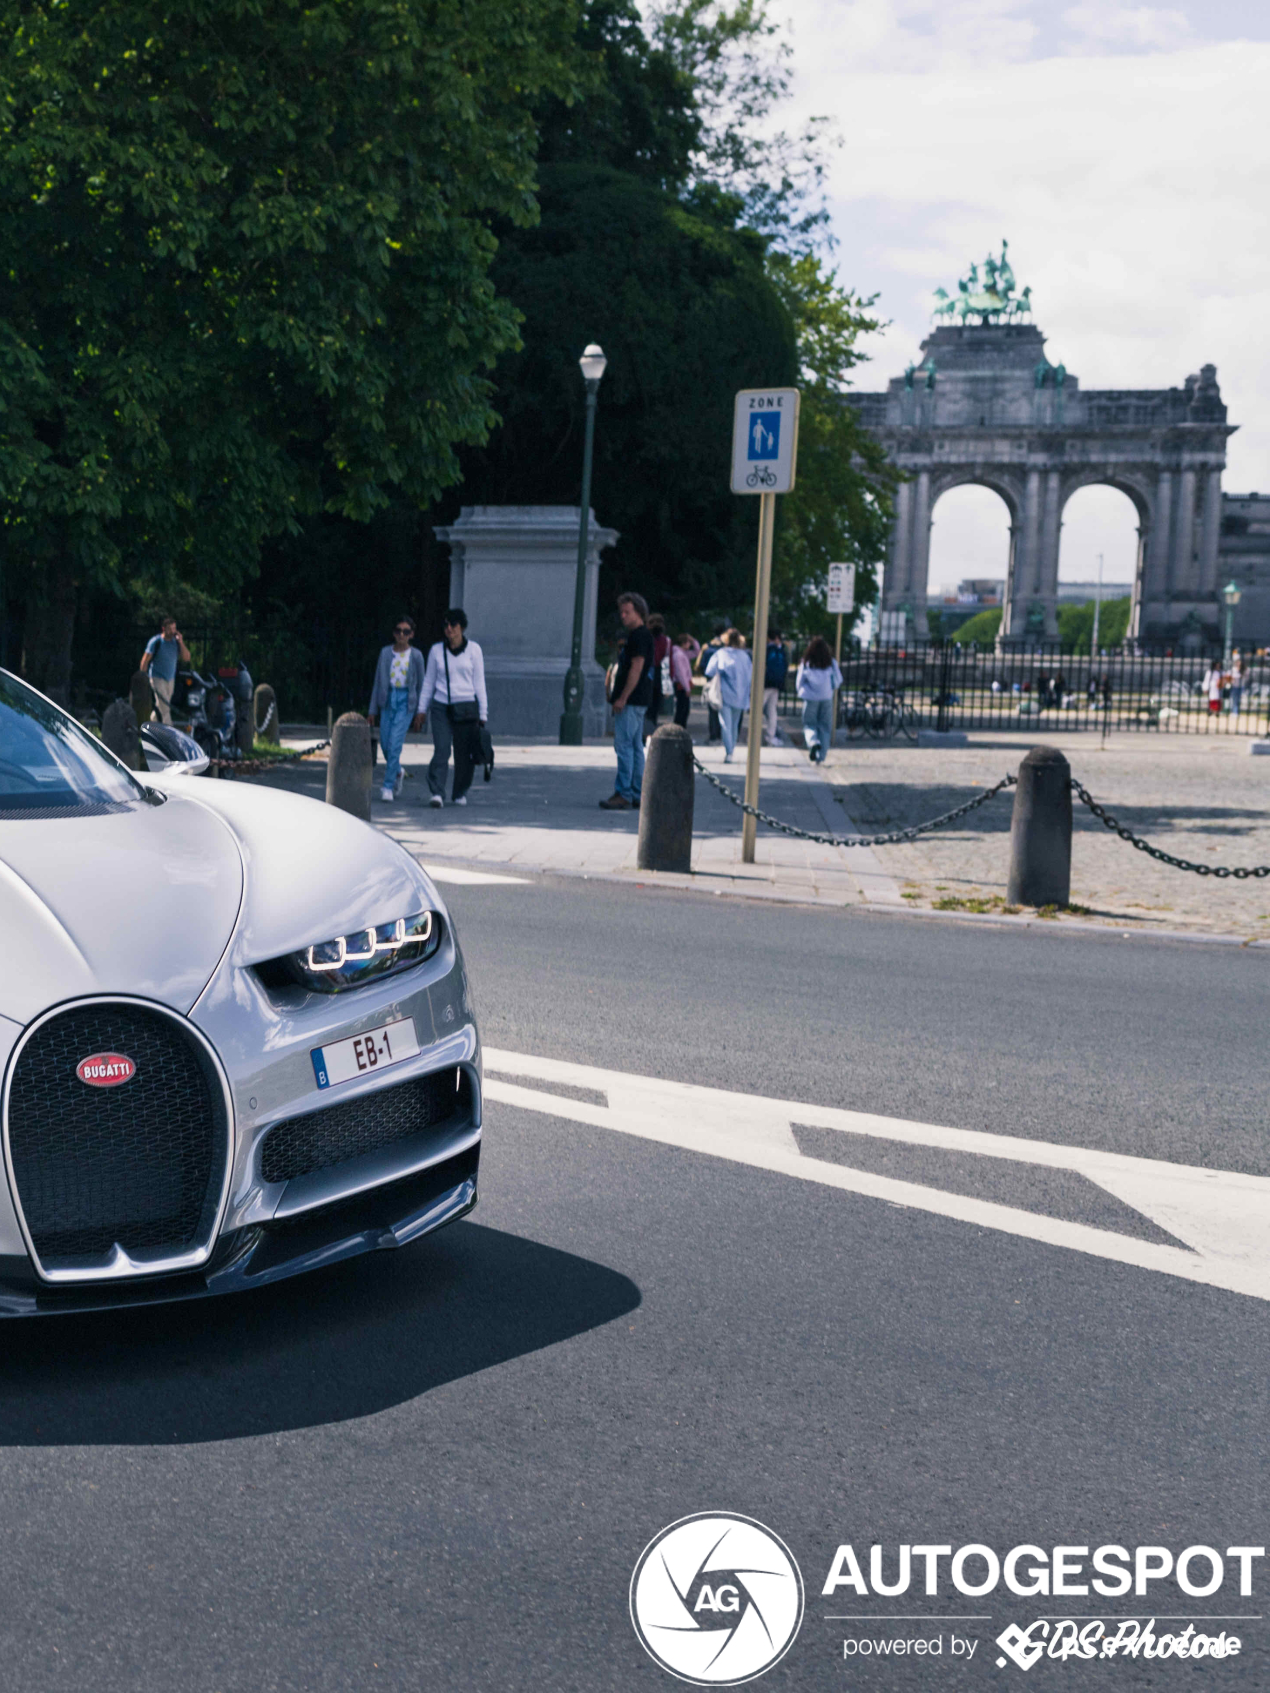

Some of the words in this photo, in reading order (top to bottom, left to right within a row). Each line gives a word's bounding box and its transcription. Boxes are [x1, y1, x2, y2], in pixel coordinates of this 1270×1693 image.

[748, 396, 784, 409] ZONE
[352, 1030, 393, 1071] EB-1
[83, 1062, 130, 1079] BUGATTI
[318, 1071, 327, 1085] B
